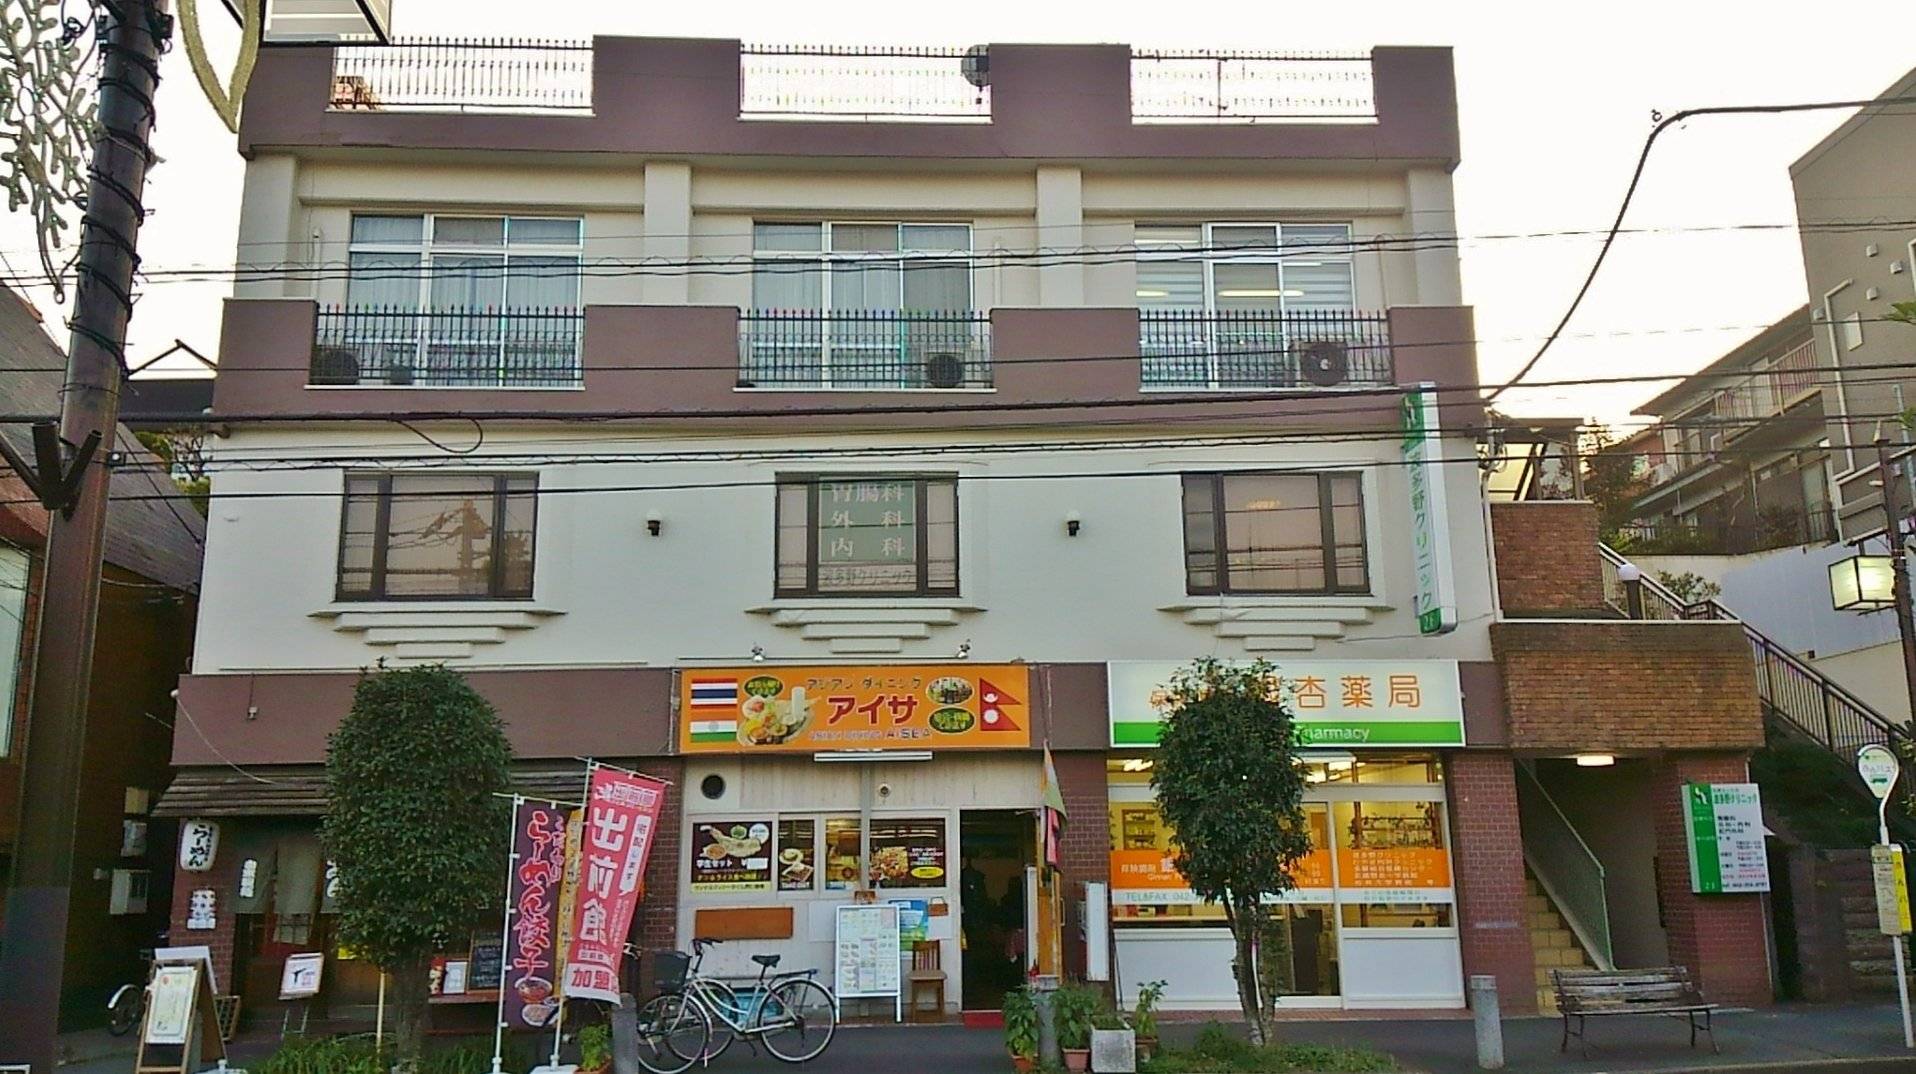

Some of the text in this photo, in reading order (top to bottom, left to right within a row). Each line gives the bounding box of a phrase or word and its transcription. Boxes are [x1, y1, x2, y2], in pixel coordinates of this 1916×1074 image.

[831, 537, 905, 557] 内科
[828, 694, 918, 725] アイサ
[1297, 725, 1370, 743] armacy
[189, 824, 208, 867] らーめん
